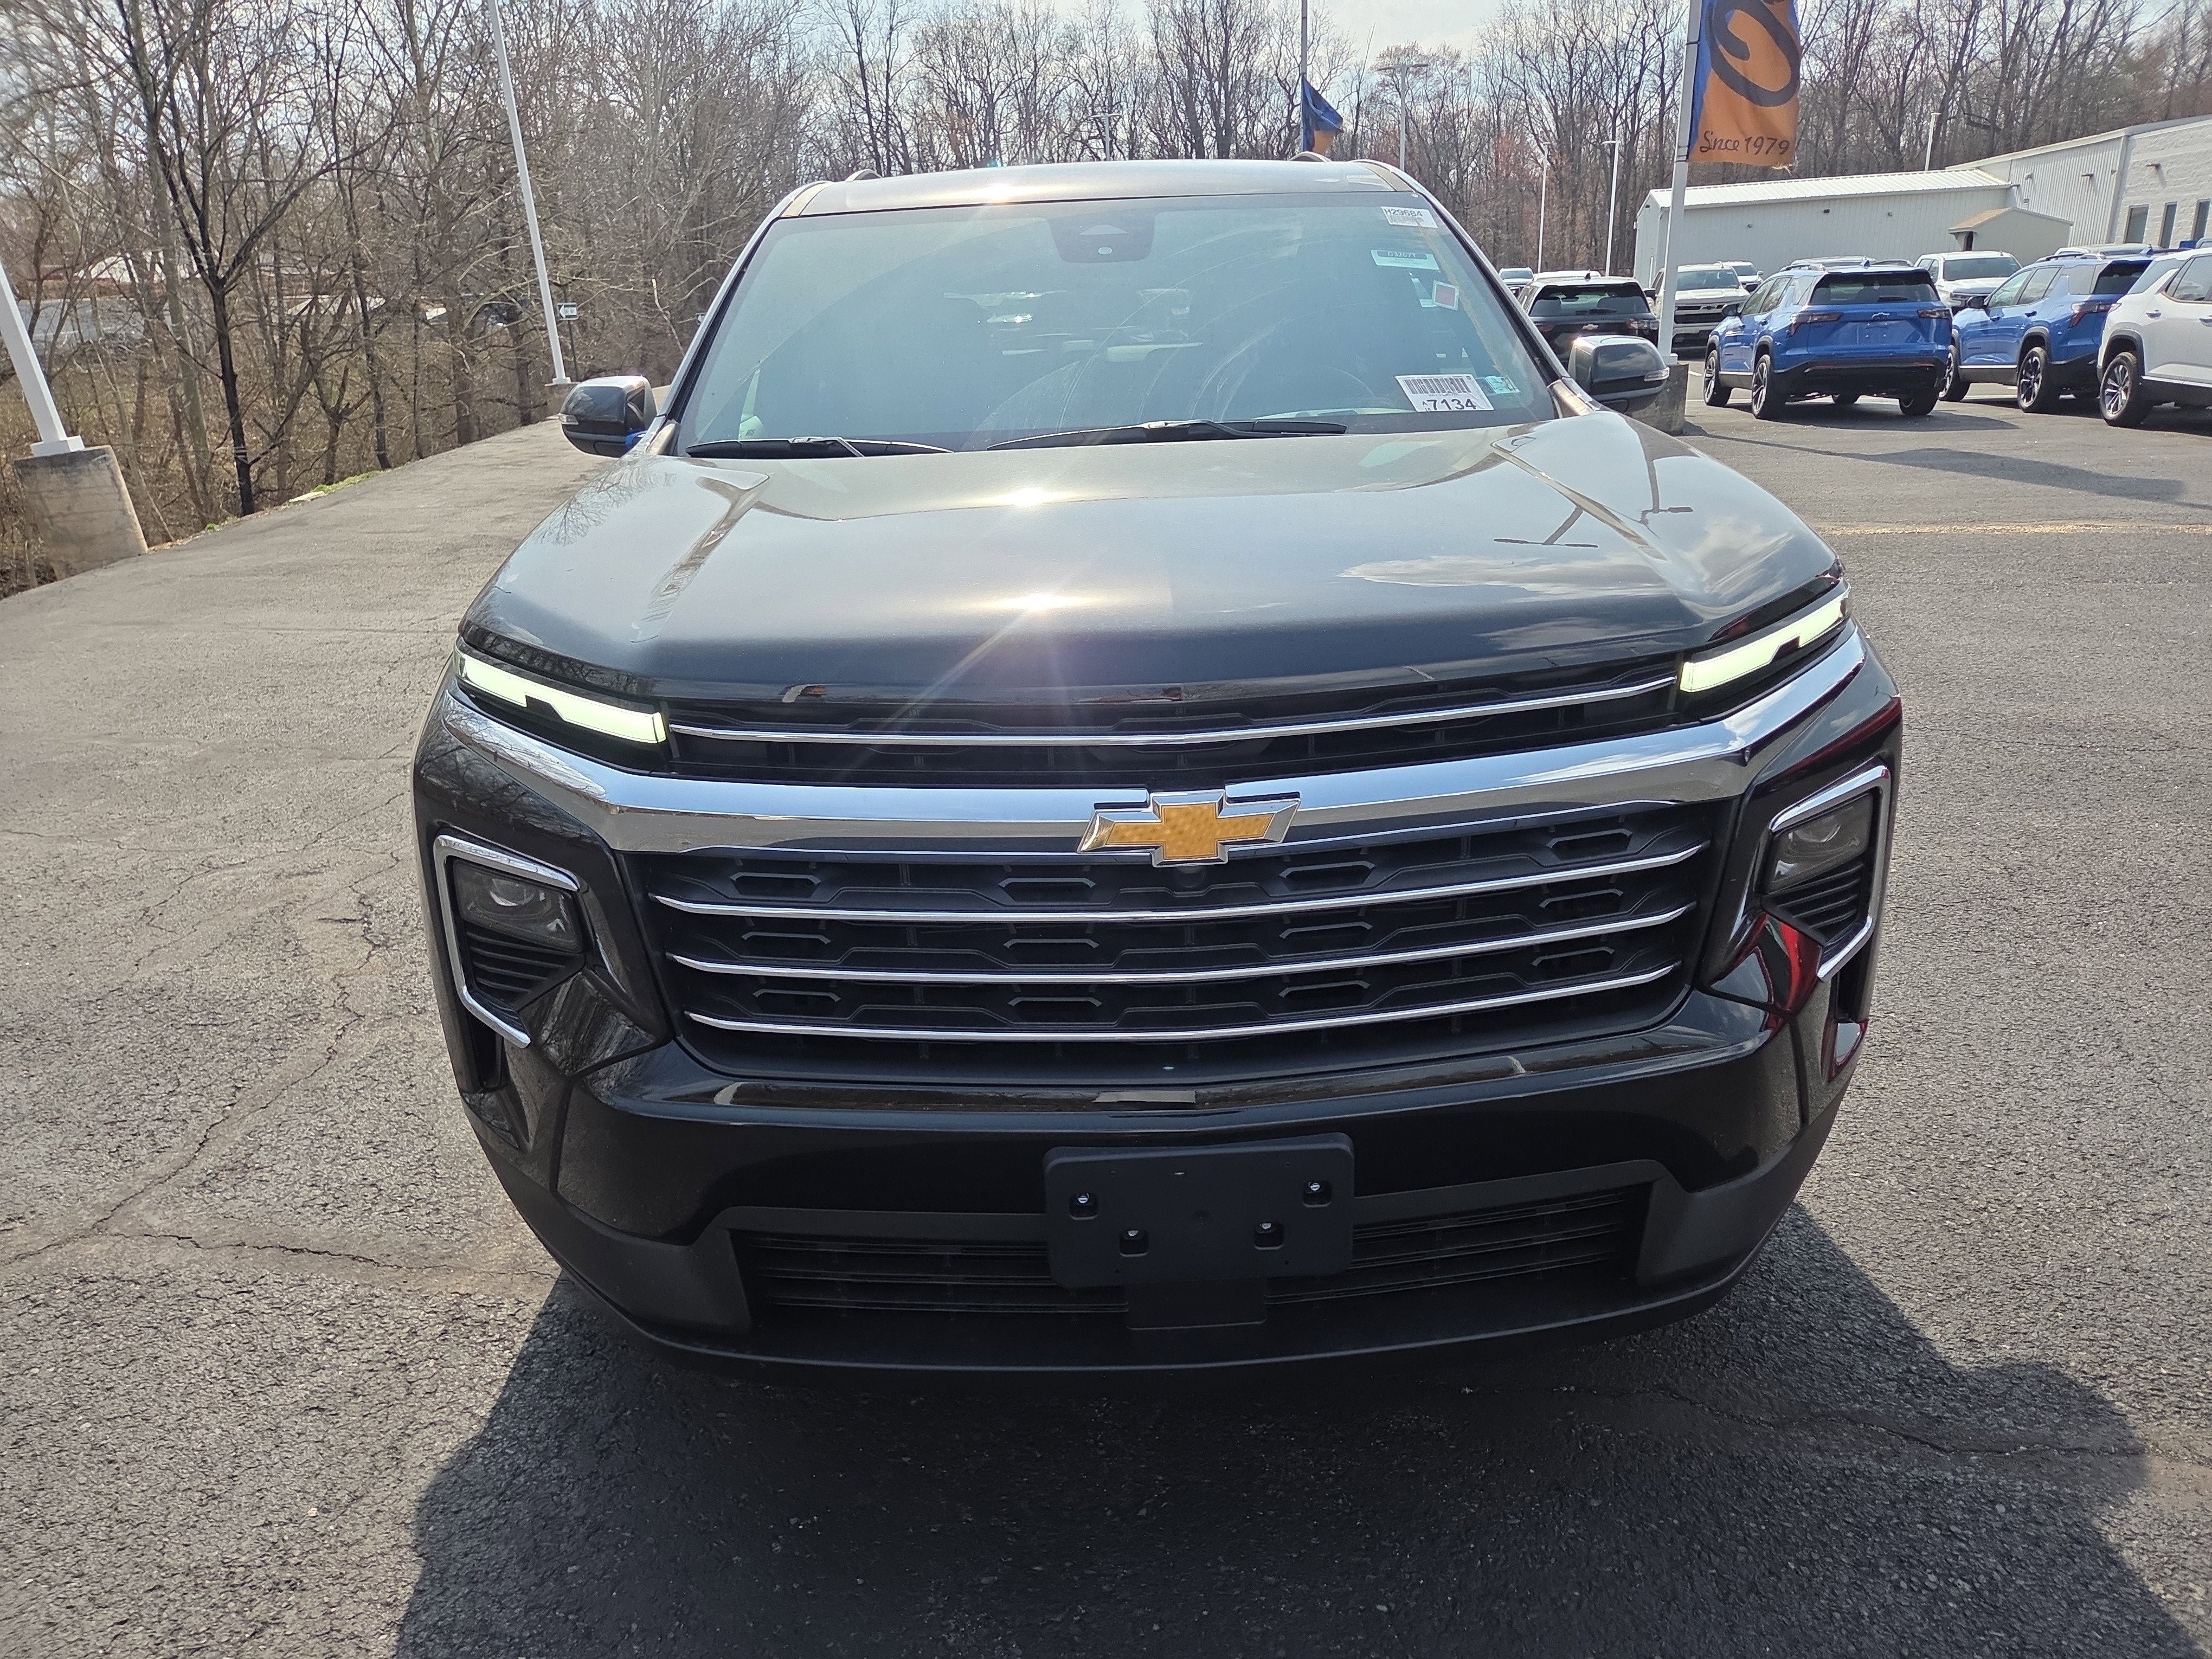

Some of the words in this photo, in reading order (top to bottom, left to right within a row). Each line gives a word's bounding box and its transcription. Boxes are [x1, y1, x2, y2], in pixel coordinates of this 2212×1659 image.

[1700, 130, 1739, 153] Since
[1745, 137, 1790, 155] 1979
[1426, 398, 1477, 410] 7134
